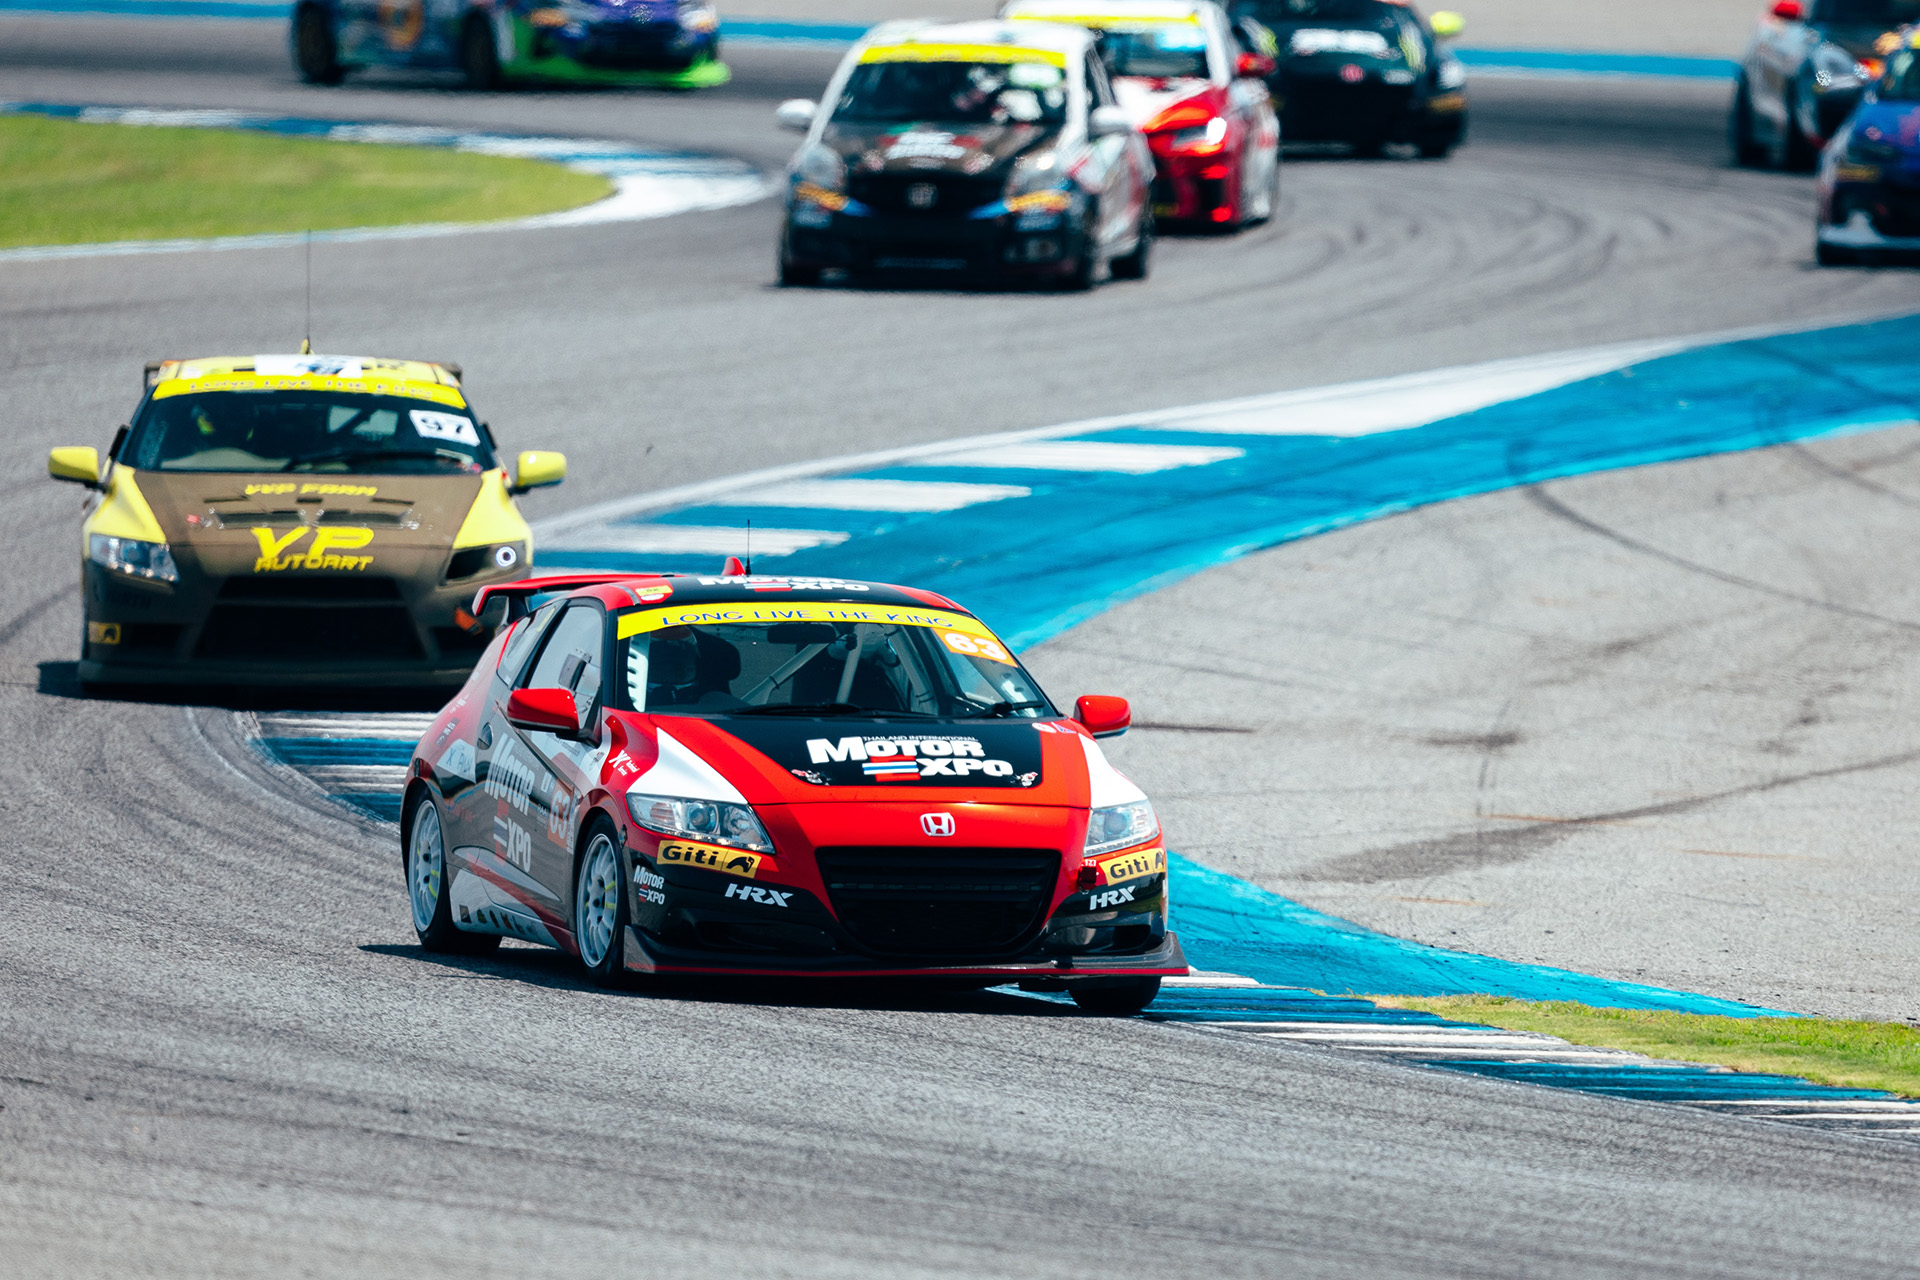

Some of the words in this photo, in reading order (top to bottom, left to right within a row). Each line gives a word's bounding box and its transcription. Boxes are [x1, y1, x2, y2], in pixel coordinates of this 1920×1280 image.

[251, 525, 375, 558] YP
[254, 552, 374, 573] AUTOART
[697, 575, 846, 586] MOTOR
[662, 611, 744, 626] LONG
[754, 610, 815, 619] LIVE
[822, 610, 879, 621] THE
[886, 612, 953, 628] KING
[944, 632, 1007, 660] 63
[806, 736, 986, 764] MOTOR
[908, 734, 979, 742] INTERNATIONAL
[484, 732, 536, 816] MOTOR
[549, 789, 571, 840] 63
[662, 845, 719, 866] Giti
[1109, 856, 1150, 879] Giti
[633, 864, 665, 890] MOTOR
[724, 882, 794, 908] HRX
[1089, 885, 1136, 911] HRX
